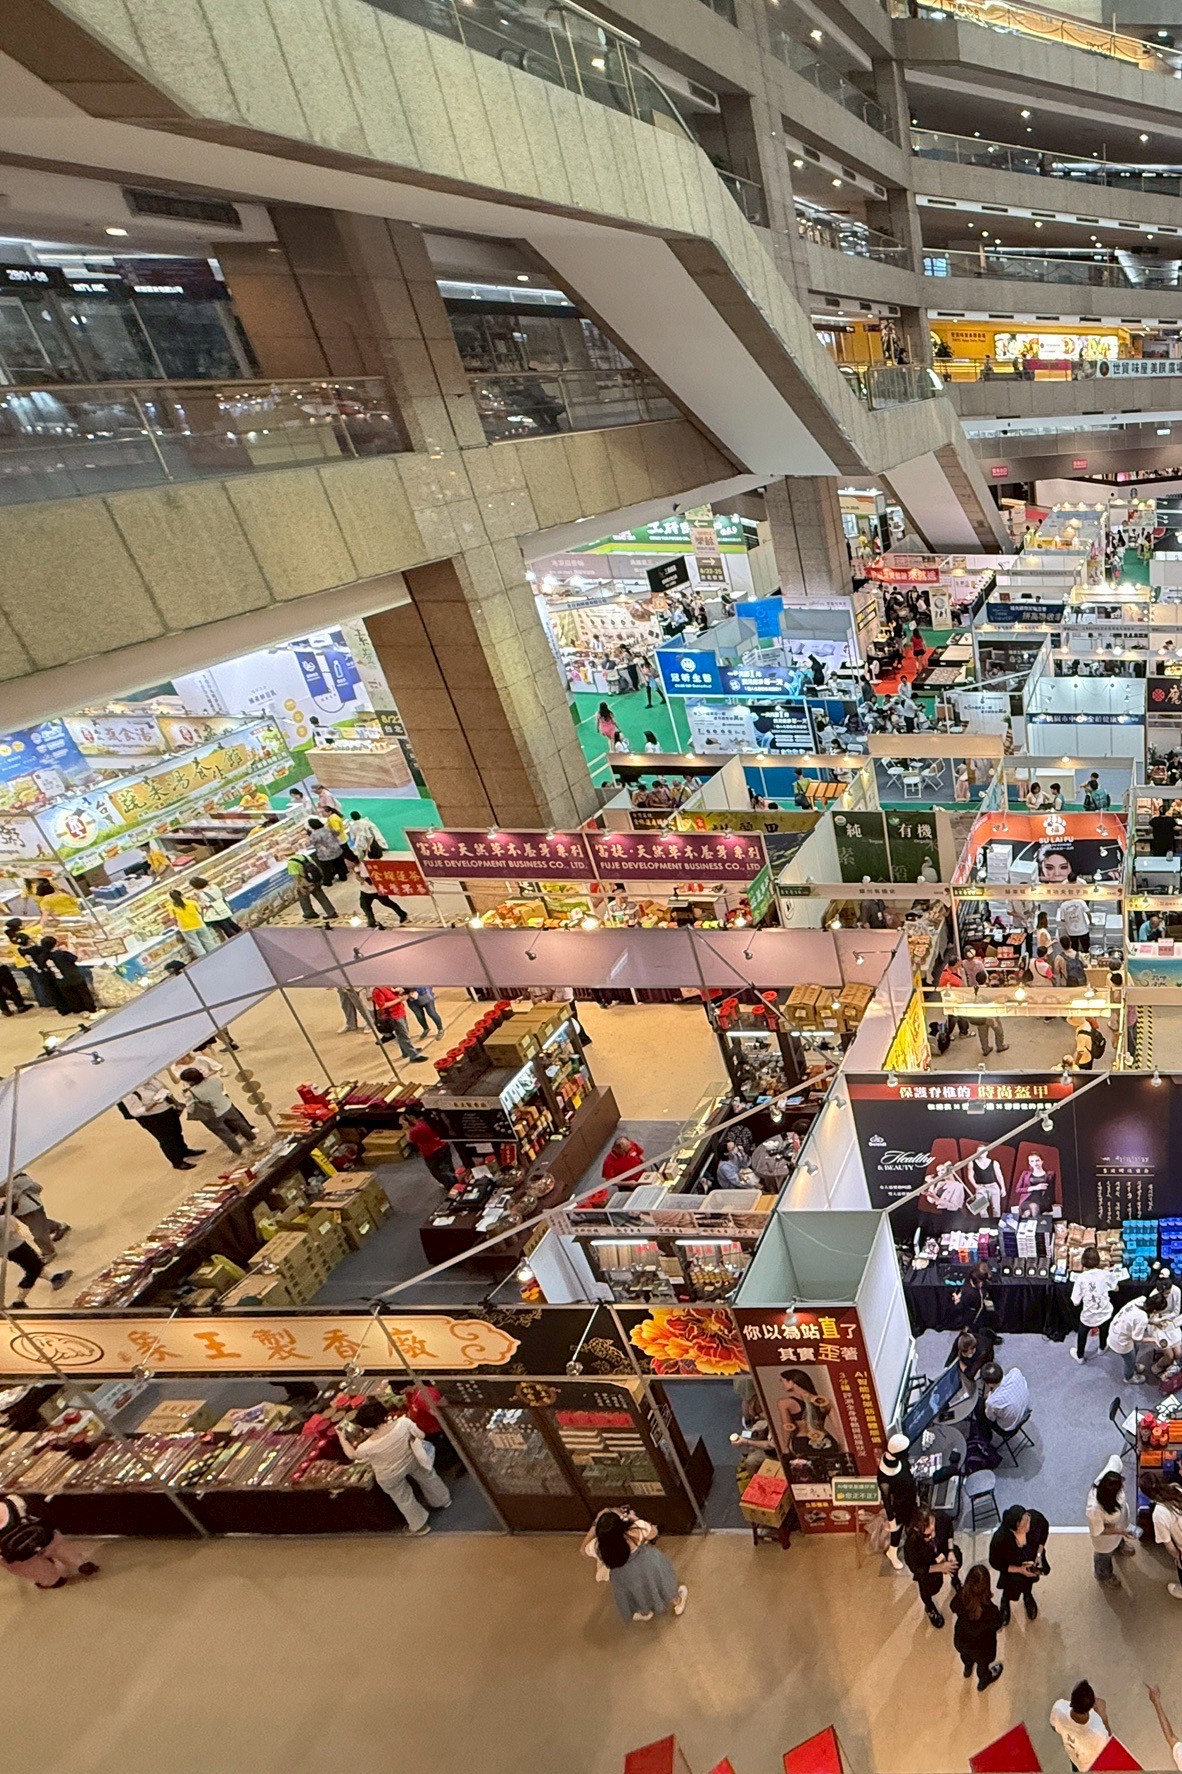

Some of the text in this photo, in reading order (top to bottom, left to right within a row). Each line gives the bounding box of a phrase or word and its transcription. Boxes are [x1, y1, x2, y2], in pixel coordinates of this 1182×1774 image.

[845, 823, 863, 838] 純
[898, 823, 933, 839] 有機
[1038, 836, 1075, 845] SU LAI FU
[423, 860, 444, 868] FUJE
[444, 860, 508, 869] DEVELOPMENT
[508, 861, 548, 869] BUSINESS
[621, 862, 683, 870] DEVELOPMENT
[684, 862, 724, 870] BUSINESS
[900, 1085, 1049, 1099] 保護脊椎的 時尚盔甲
[880, 1150, 937, 1168] Healthy
[743, 1316, 858, 1341] 你以為站直了
[777, 1342, 859, 1363] 其實歪著
